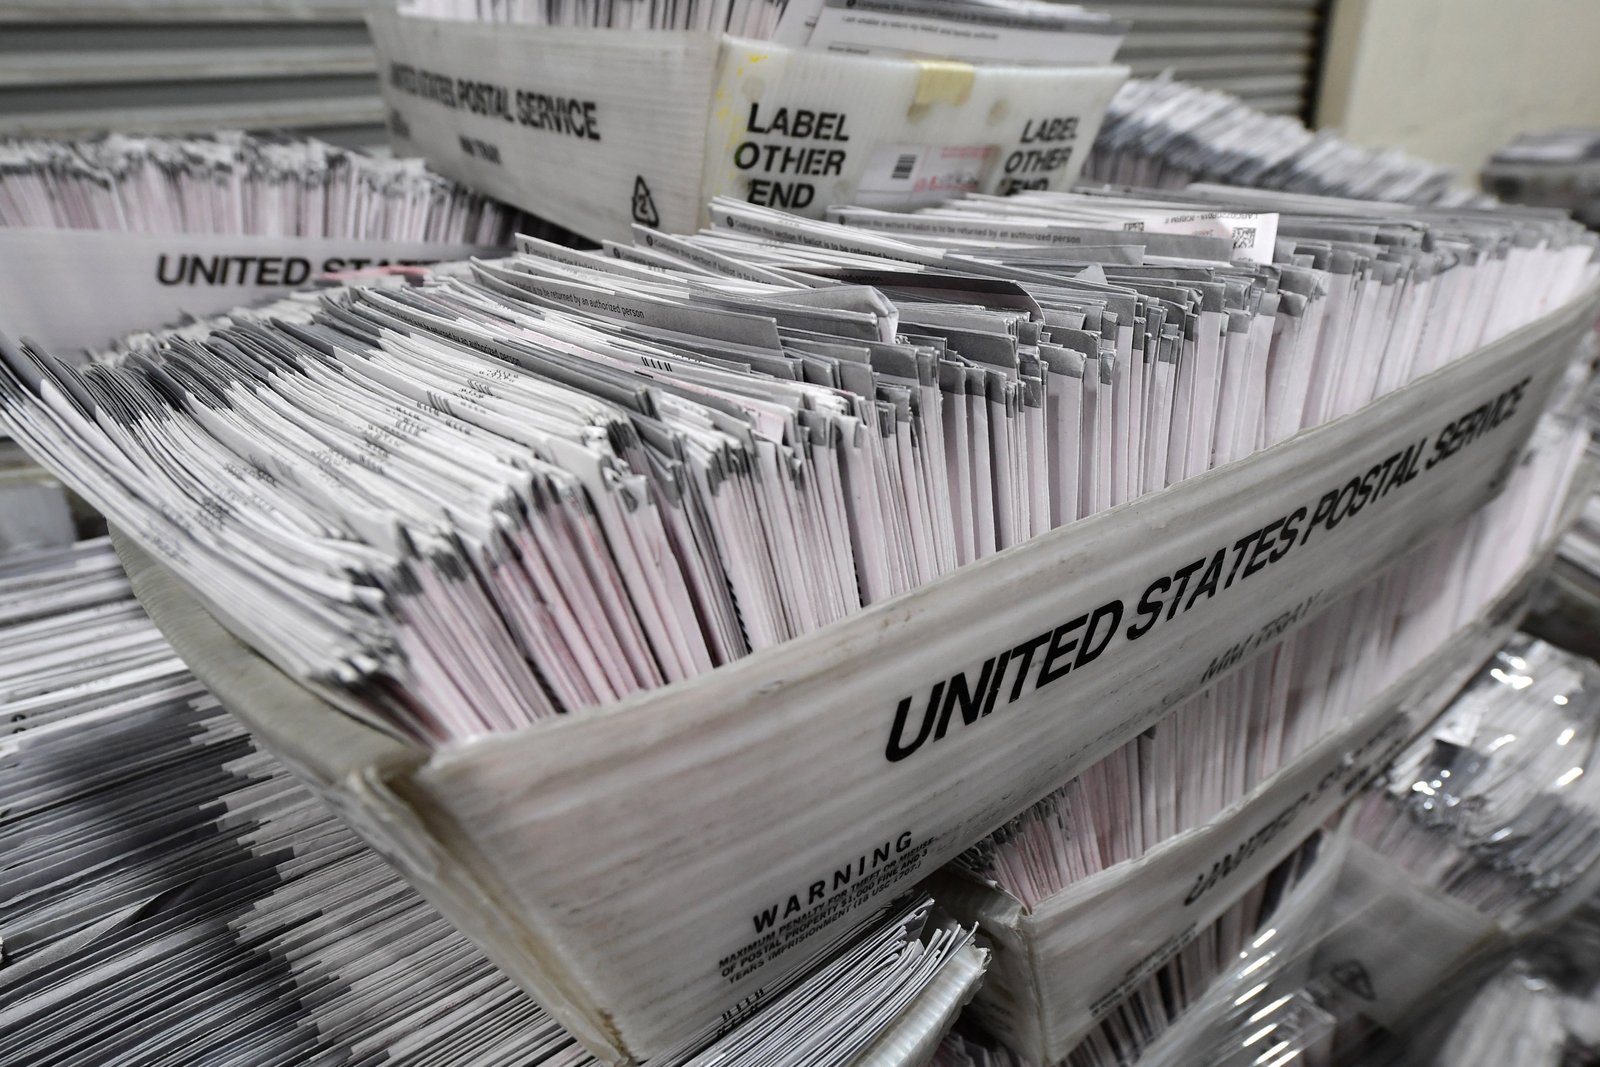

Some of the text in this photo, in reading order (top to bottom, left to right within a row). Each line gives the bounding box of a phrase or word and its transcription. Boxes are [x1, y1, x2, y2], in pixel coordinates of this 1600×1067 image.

[457, 79, 514, 122] POSTAL
[516, 89, 600, 140] SERVICE
[747, 102, 849, 141] LABEL
[1020, 117, 1080, 143] LABEL
[734, 141, 846, 176] OTHER
[1004, 146, 1073, 173] OTHER
[747, 178, 815, 209] END
[803, 235, 822, 247] ballot
[839, 243, 849, 252] be
[957, 227, 987, 236] returned
[988, 228, 997, 238] by
[1010, 231, 1051, 241] authorized
[1053, 234, 1081, 244] person
[156, 254, 312, 286] UNITED
[717, 262, 735, 276] ballot
[550, 290, 573, 303] returned
[573, 293, 581, 307] by
[582, 297, 590, 306] an
[590, 299, 621, 313] authorized
[621, 306, 645, 319] person
[468, 340, 499, 358] authorized
[499, 352, 522, 367] person
[885, 376, 1532, 762] UNITED STATES POSTAL SERVICE
[753, 830, 912, 934] WARNING
[719, 930, 776, 969] MAXIMUM
[779, 902, 825, 935] PENALTY
[827, 889, 848, 908] FOR
[851, 867, 881, 892] THEFT
[883, 858, 897, 873] OR
[721, 962, 736, 977] OF
[740, 939, 782, 967] POSTAL
[785, 904, 838, 941] PROPERTY
[841, 882, 876, 908] $1,000
[877, 867, 899, 887] FINE
[900, 855, 920, 872] AND
[730, 961, 764, 984] YEARS
[872, 881, 891, 897] USC
